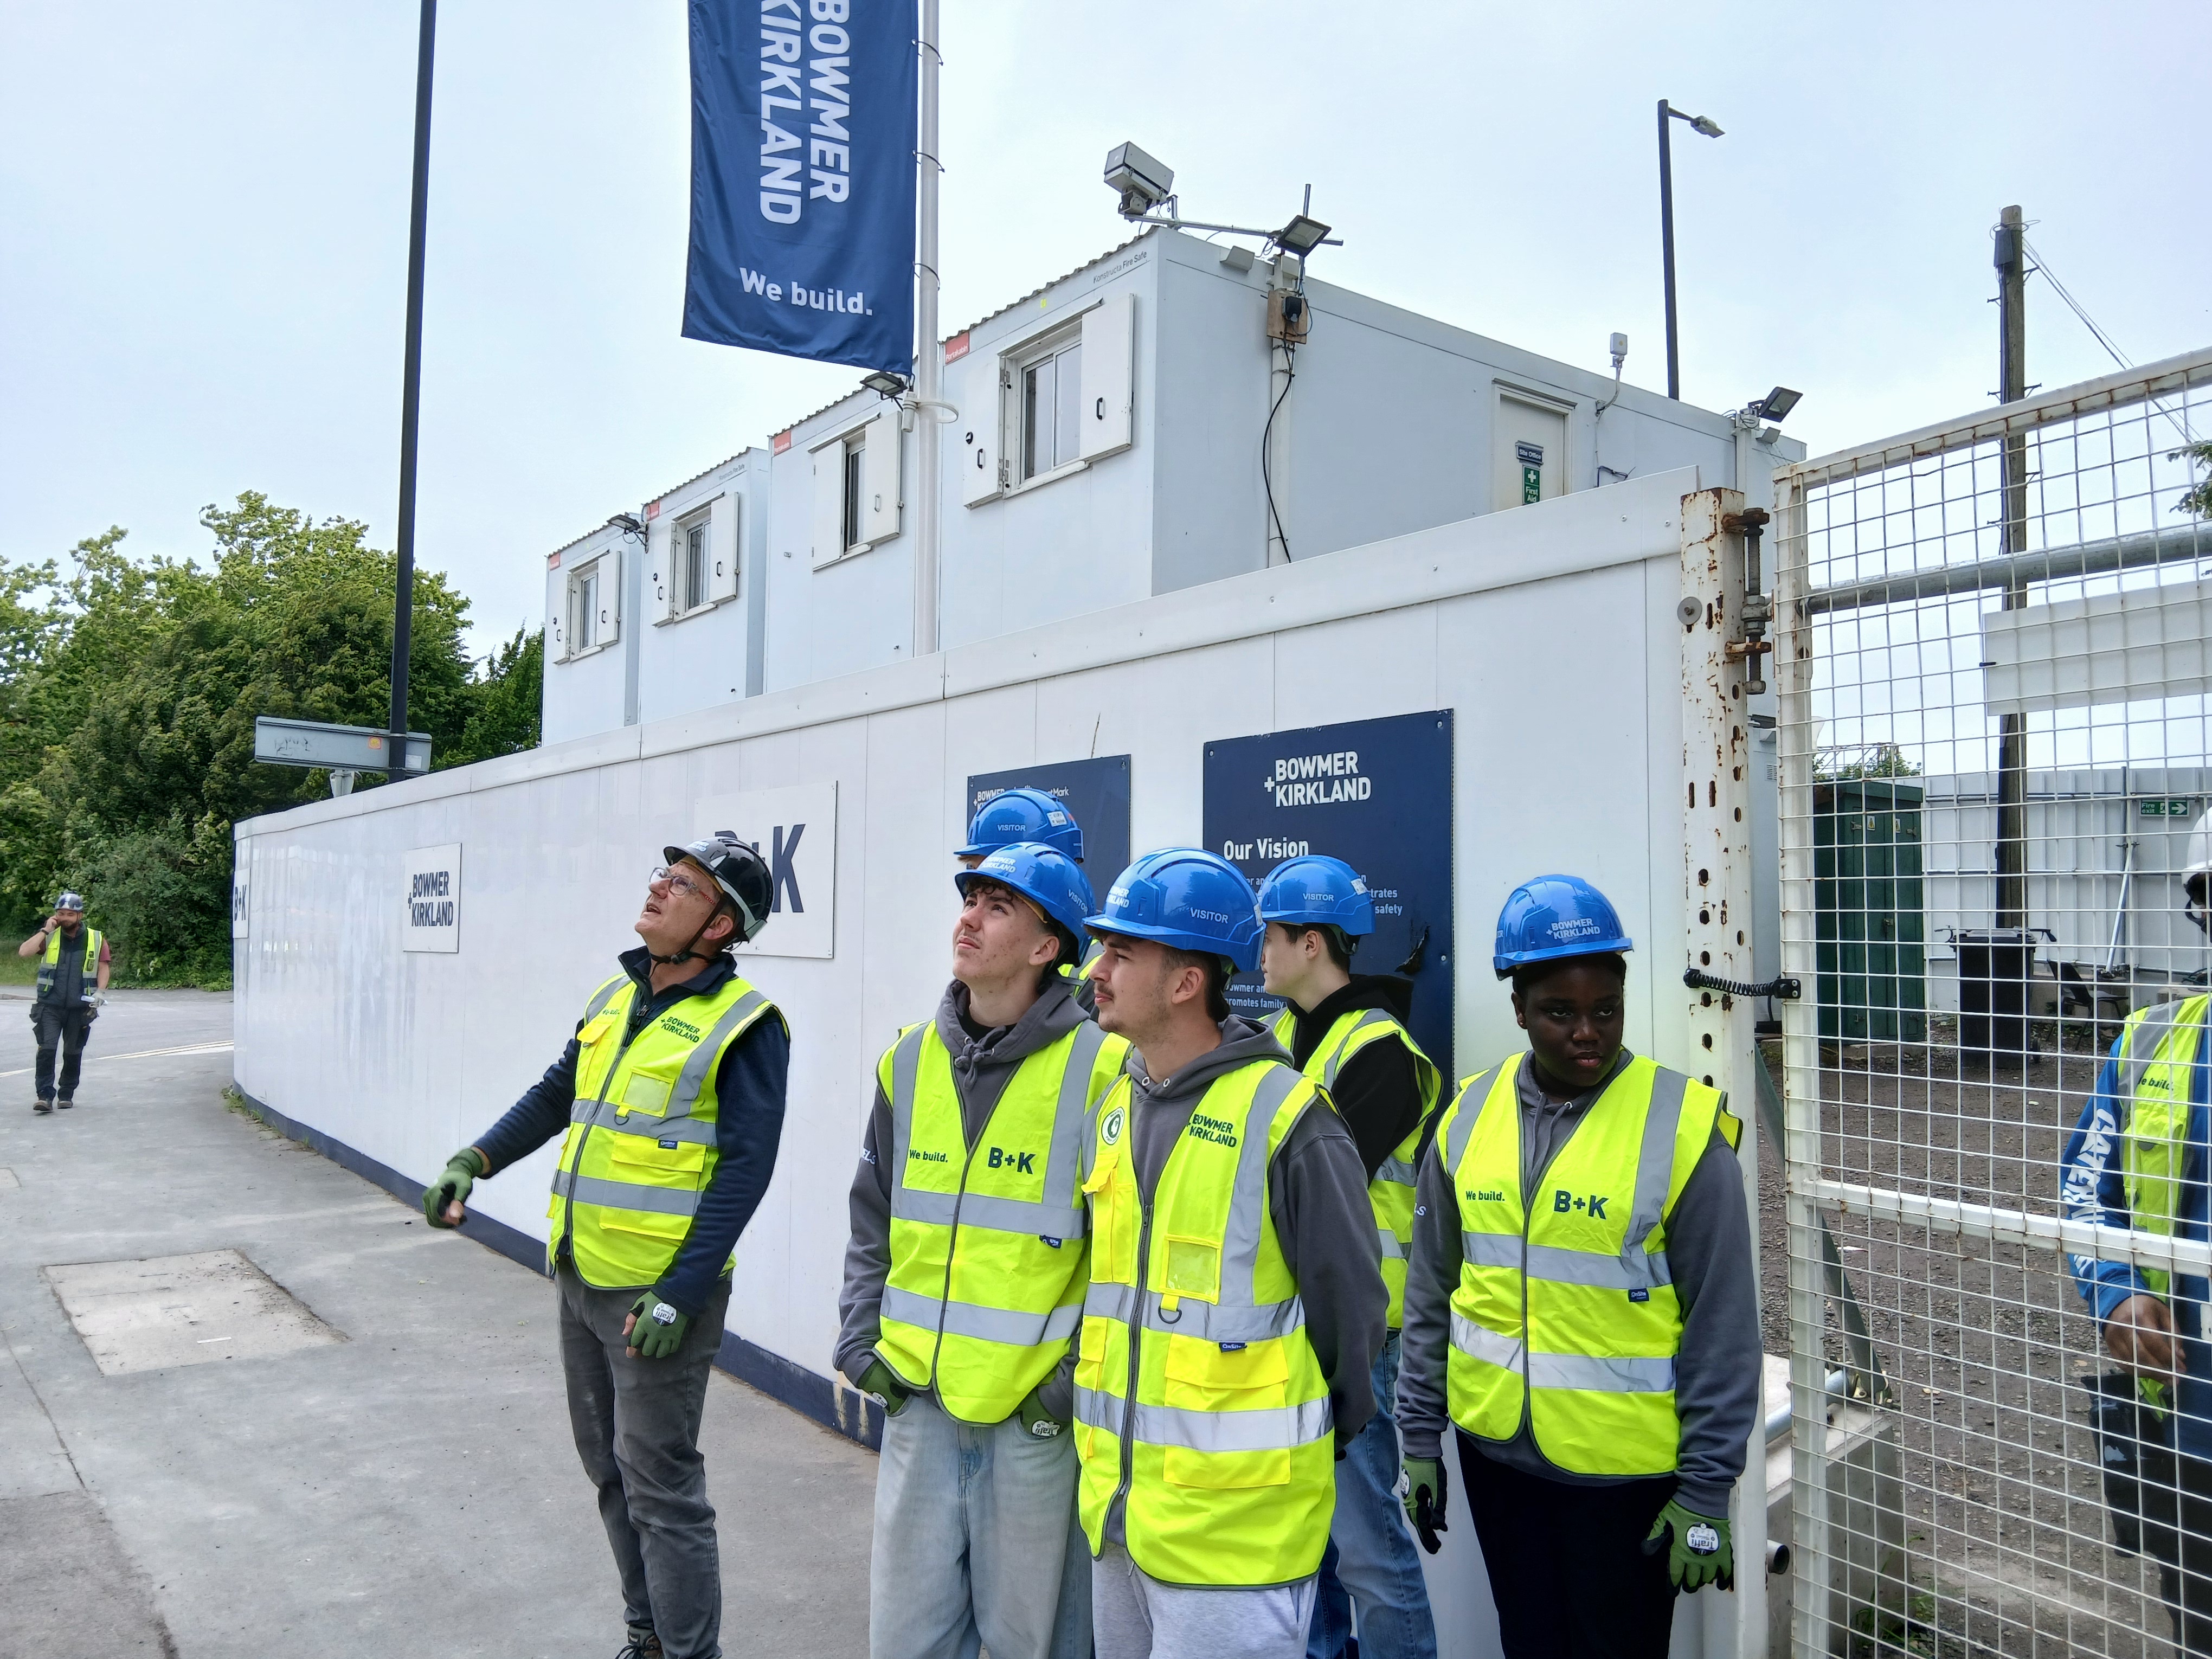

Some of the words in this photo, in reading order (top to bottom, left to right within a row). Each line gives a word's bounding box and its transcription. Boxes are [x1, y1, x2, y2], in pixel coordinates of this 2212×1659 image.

[809, 0, 850, 203] BOWMER
[1093, 265, 1122, 284] Konstructa
[1122, 259, 1134, 269] Fire
[1134, 251, 1147, 263] Safe
[739, 267, 783, 301] We
[791, 281, 873, 316] build.
[1528, 451, 1542, 460] Office
[1526, 486, 1539, 496] First
[1527, 494, 1537, 503] Aid
[1275, 751, 1359, 782] BOWMER
[1276, 776, 1372, 807] KIRKLAND
[997, 824, 1026, 832] VISITOR
[1224, 840, 1253, 860] Our
[1256, 837, 1309, 859] Vision
[413, 871, 449, 898] BOWMER
[234, 885, 247, 922] B+K
[1068, 889, 1088, 915] VISITOR
[1302, 893, 1335, 902] VISITOR
[411, 901, 454, 927] KIRKLAND
[1190, 908, 1229, 924] VISITOR
[1375, 903, 1403, 916] safety
[1551, 918, 1594, 931] BOWMER
[1553, 926, 1600, 940] KIRKLAND
[1260, 998, 1284, 1009] family
[661, 1023, 700, 1043] KIRKLAND
[667, 1017, 700, 1034] BOWMER
[909, 1149, 921, 1159] We
[922, 1150, 948, 1163] build.
[987, 1147, 1036, 1175] B+K
[1465, 1191, 1476, 1200] We
[1478, 1191, 1506, 1201] build.
[1553, 1190, 1609, 1220] B+K
[1691, 1539, 1715, 1549] Traffi
